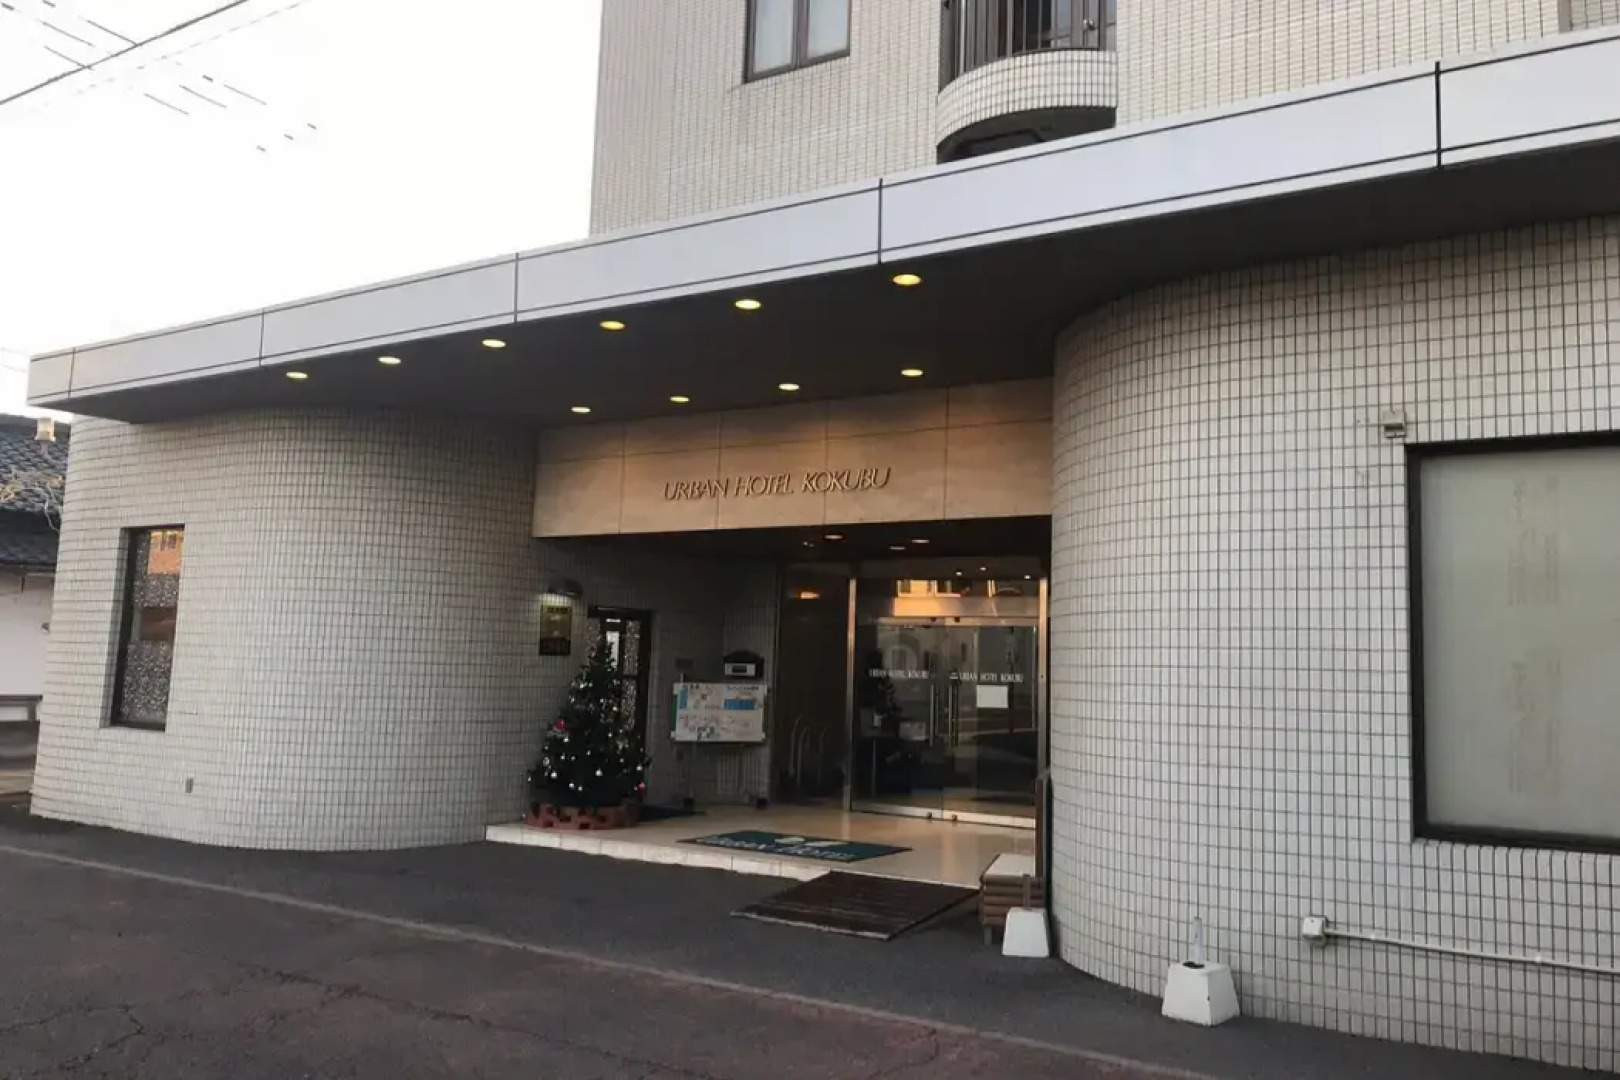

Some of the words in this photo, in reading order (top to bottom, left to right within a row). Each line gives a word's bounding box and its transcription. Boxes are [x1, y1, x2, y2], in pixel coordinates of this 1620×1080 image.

[664, 477, 729, 501] URBAN
[735, 473, 795, 497] HOTEL
[801, 467, 891, 493] KOKUBU
